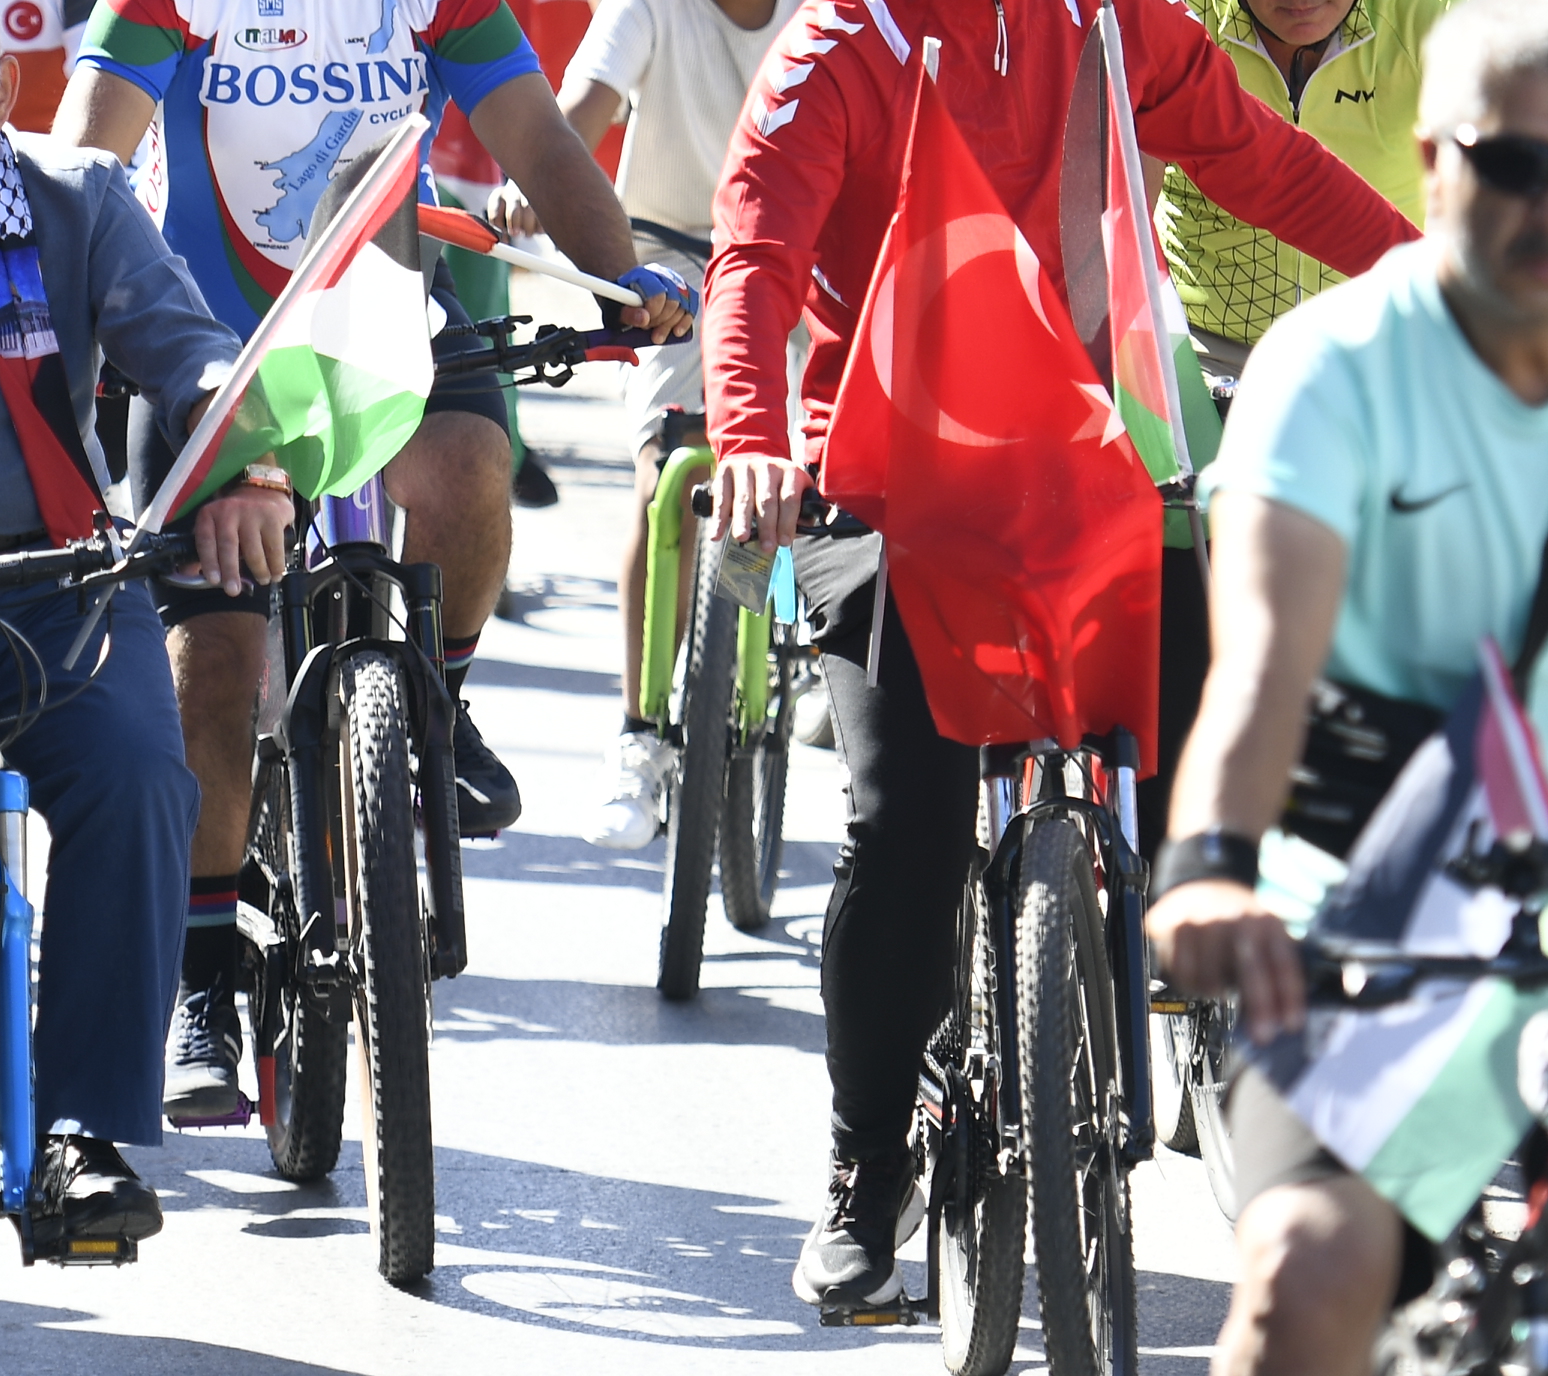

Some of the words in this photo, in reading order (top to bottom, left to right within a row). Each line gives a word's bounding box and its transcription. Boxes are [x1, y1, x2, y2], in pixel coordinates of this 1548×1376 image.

[245, 28, 295, 44] ITALIA
[369, 103, 413, 125] CYCLE
[288, 164, 317, 191] Lago
[315, 150, 330, 165] di
[325, 110, 358, 151] Garda
